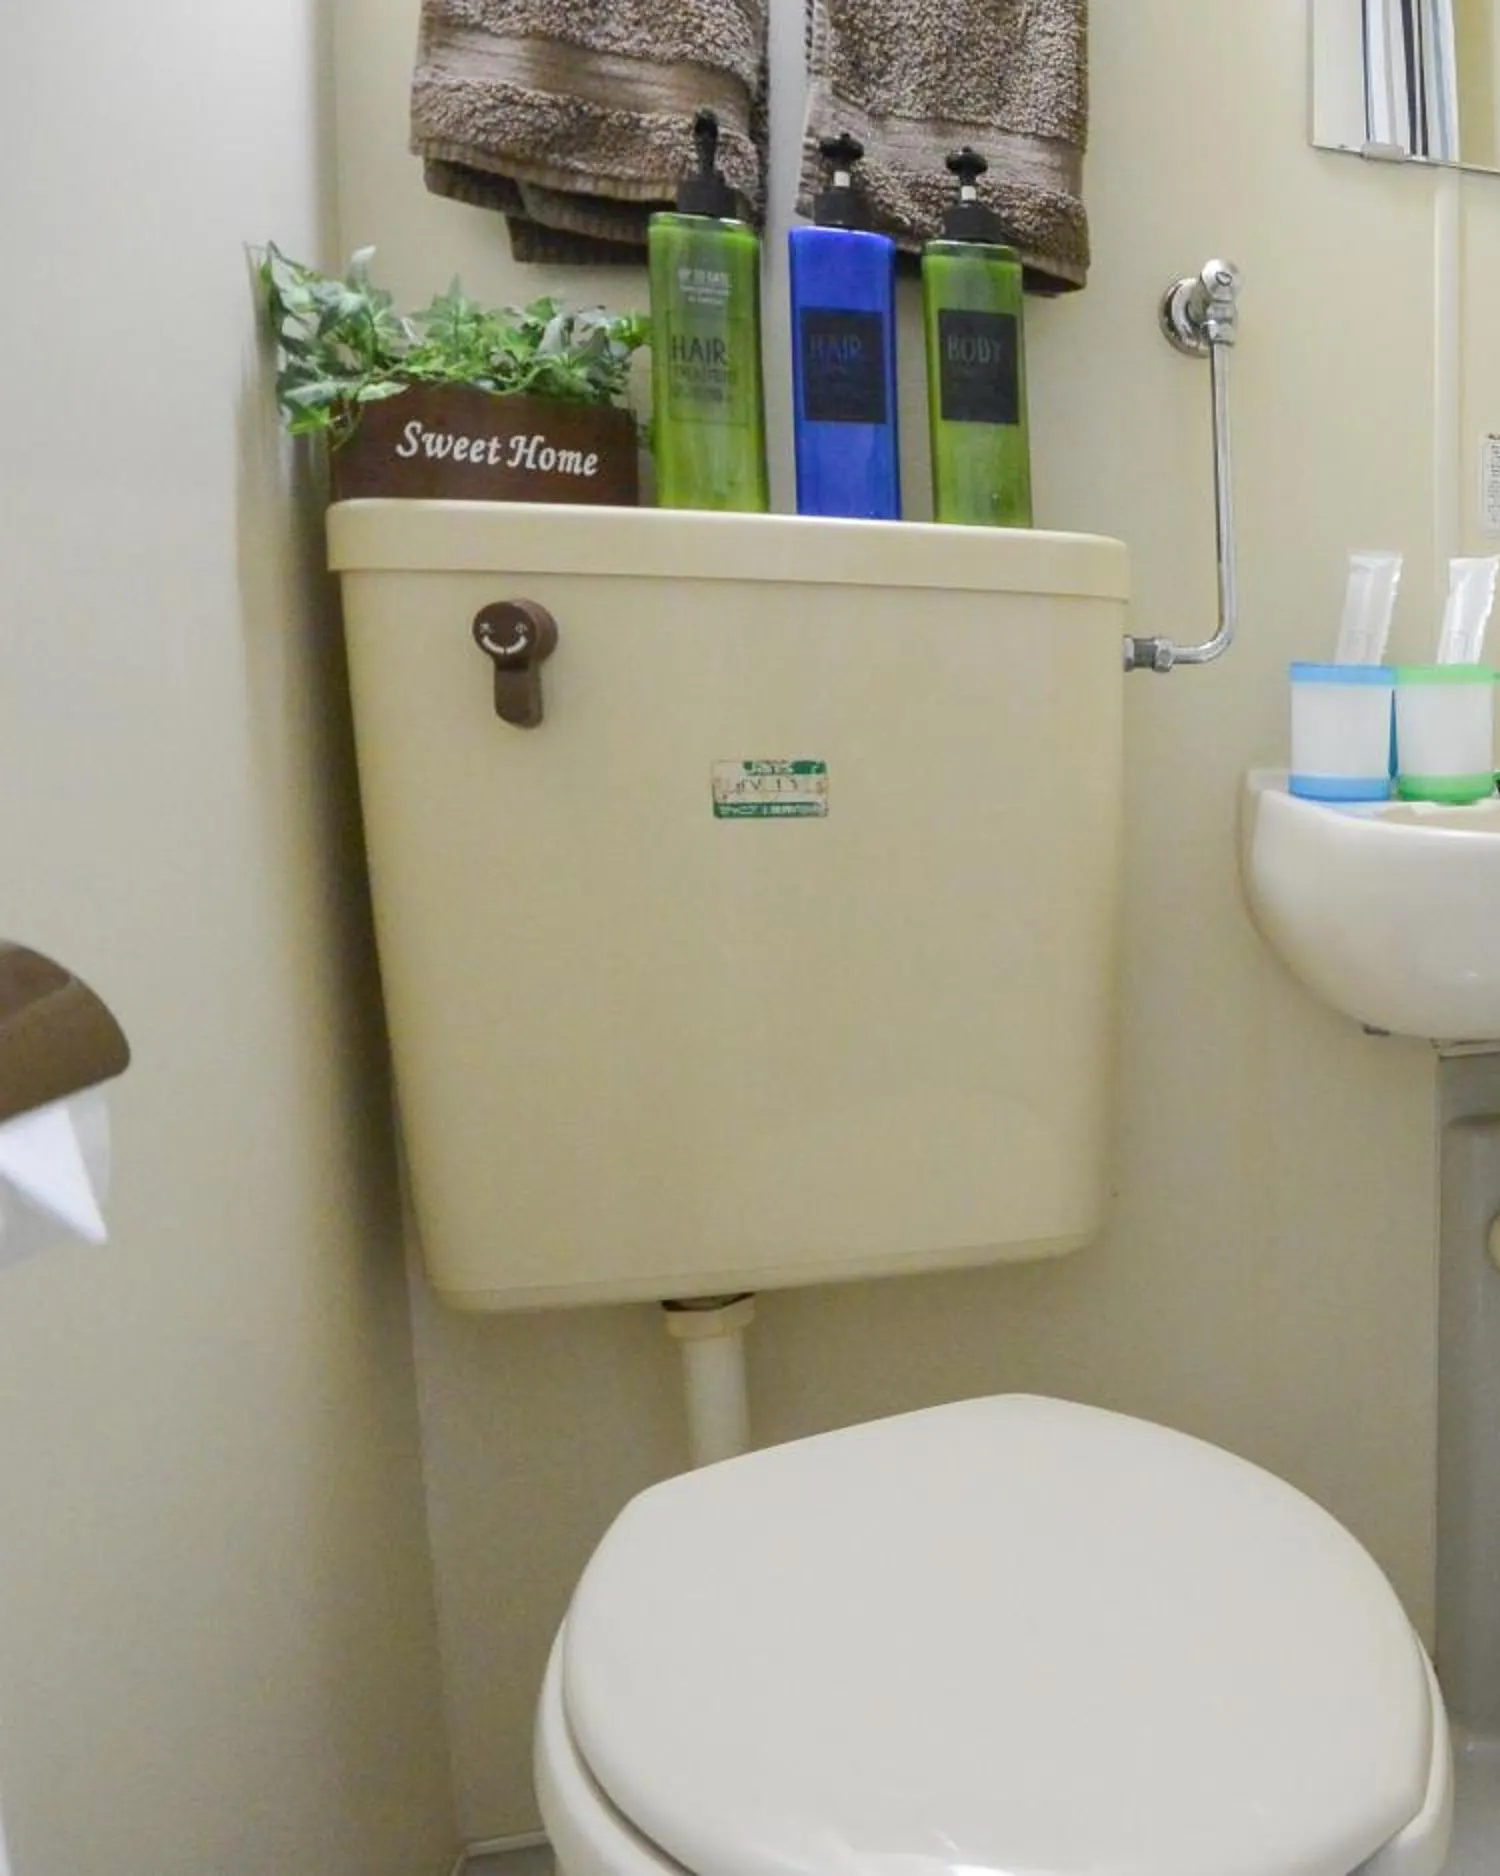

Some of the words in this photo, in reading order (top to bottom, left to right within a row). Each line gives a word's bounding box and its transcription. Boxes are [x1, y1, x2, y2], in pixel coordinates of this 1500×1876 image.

[672, 335, 729, 366] HAIR
[809, 333, 862, 362] HAIR
[946, 334, 1002, 364] BODY
[396, 420, 501, 465] Sweet
[506, 435, 599, 476] Home
